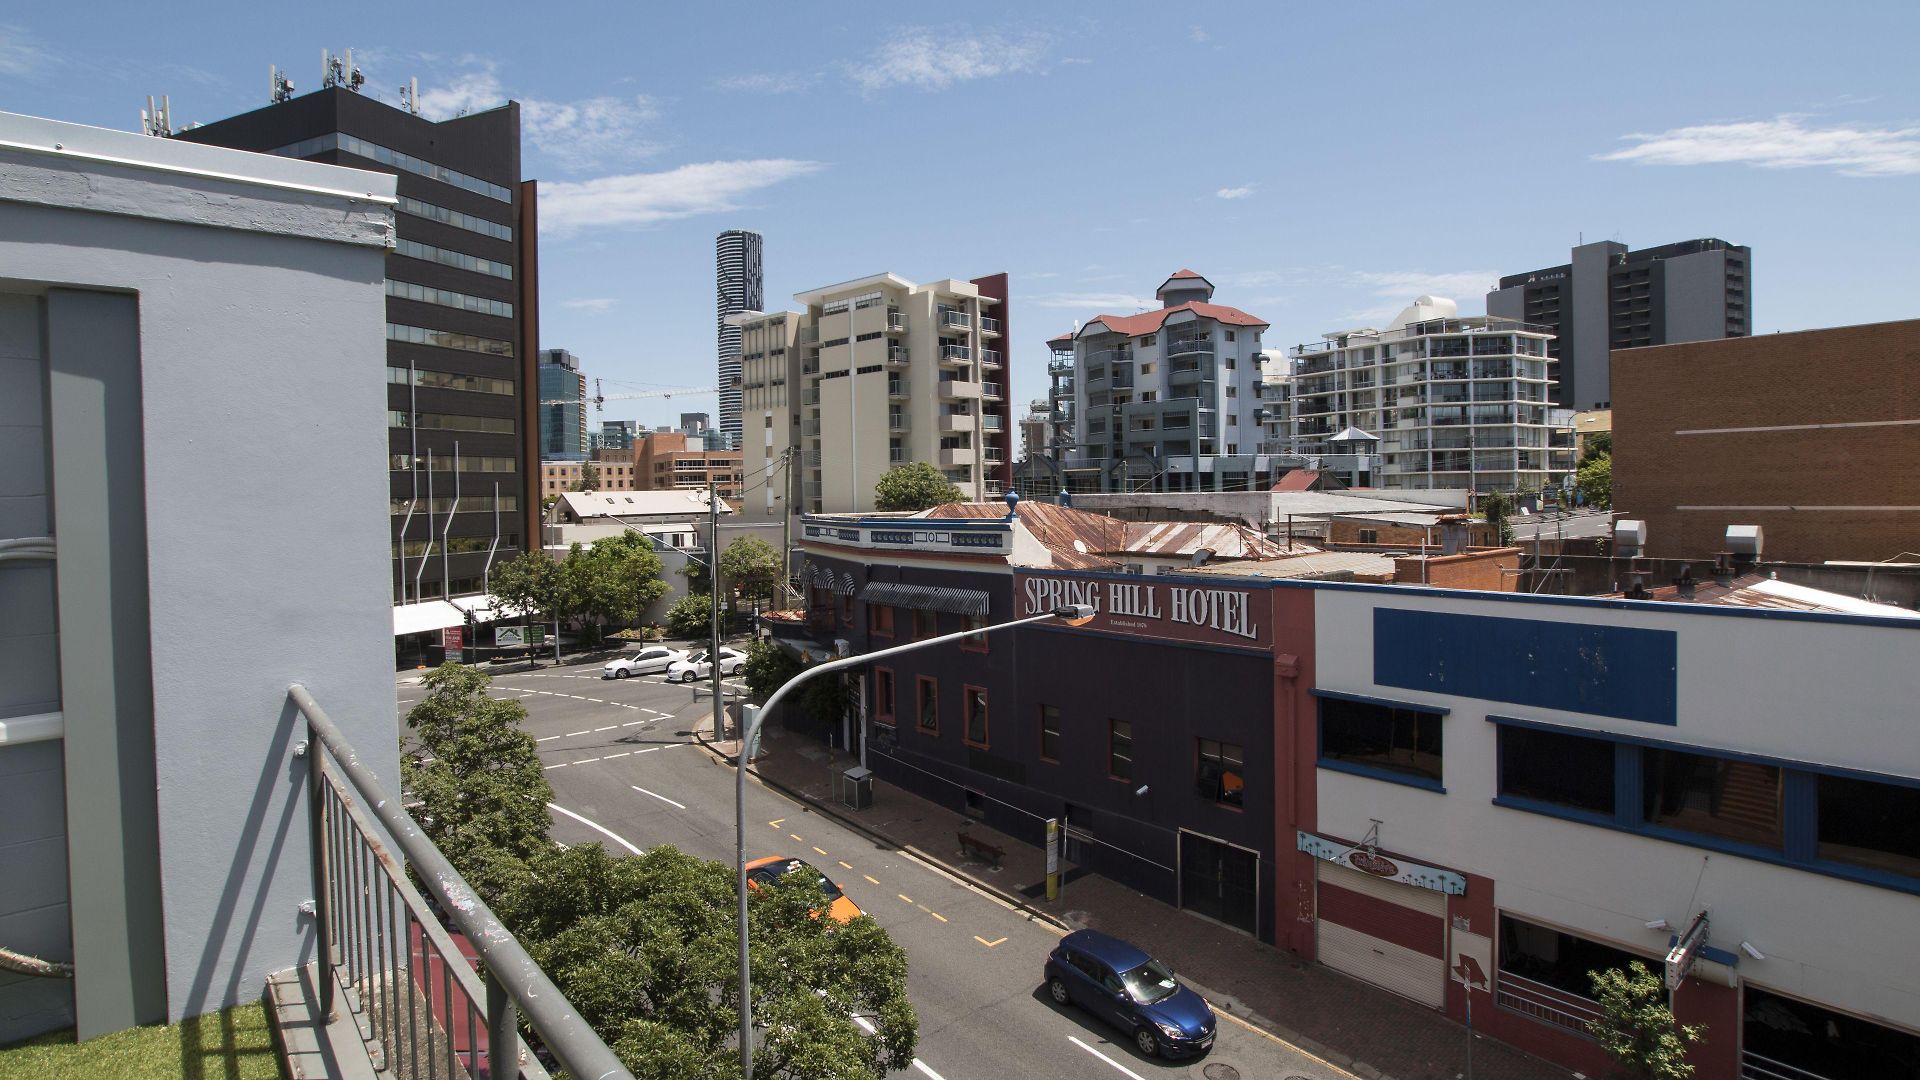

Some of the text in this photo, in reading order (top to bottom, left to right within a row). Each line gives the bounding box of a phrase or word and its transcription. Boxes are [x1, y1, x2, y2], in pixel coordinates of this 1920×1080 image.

[1025, 577, 1257, 639] SPRING HILL HOTEL
